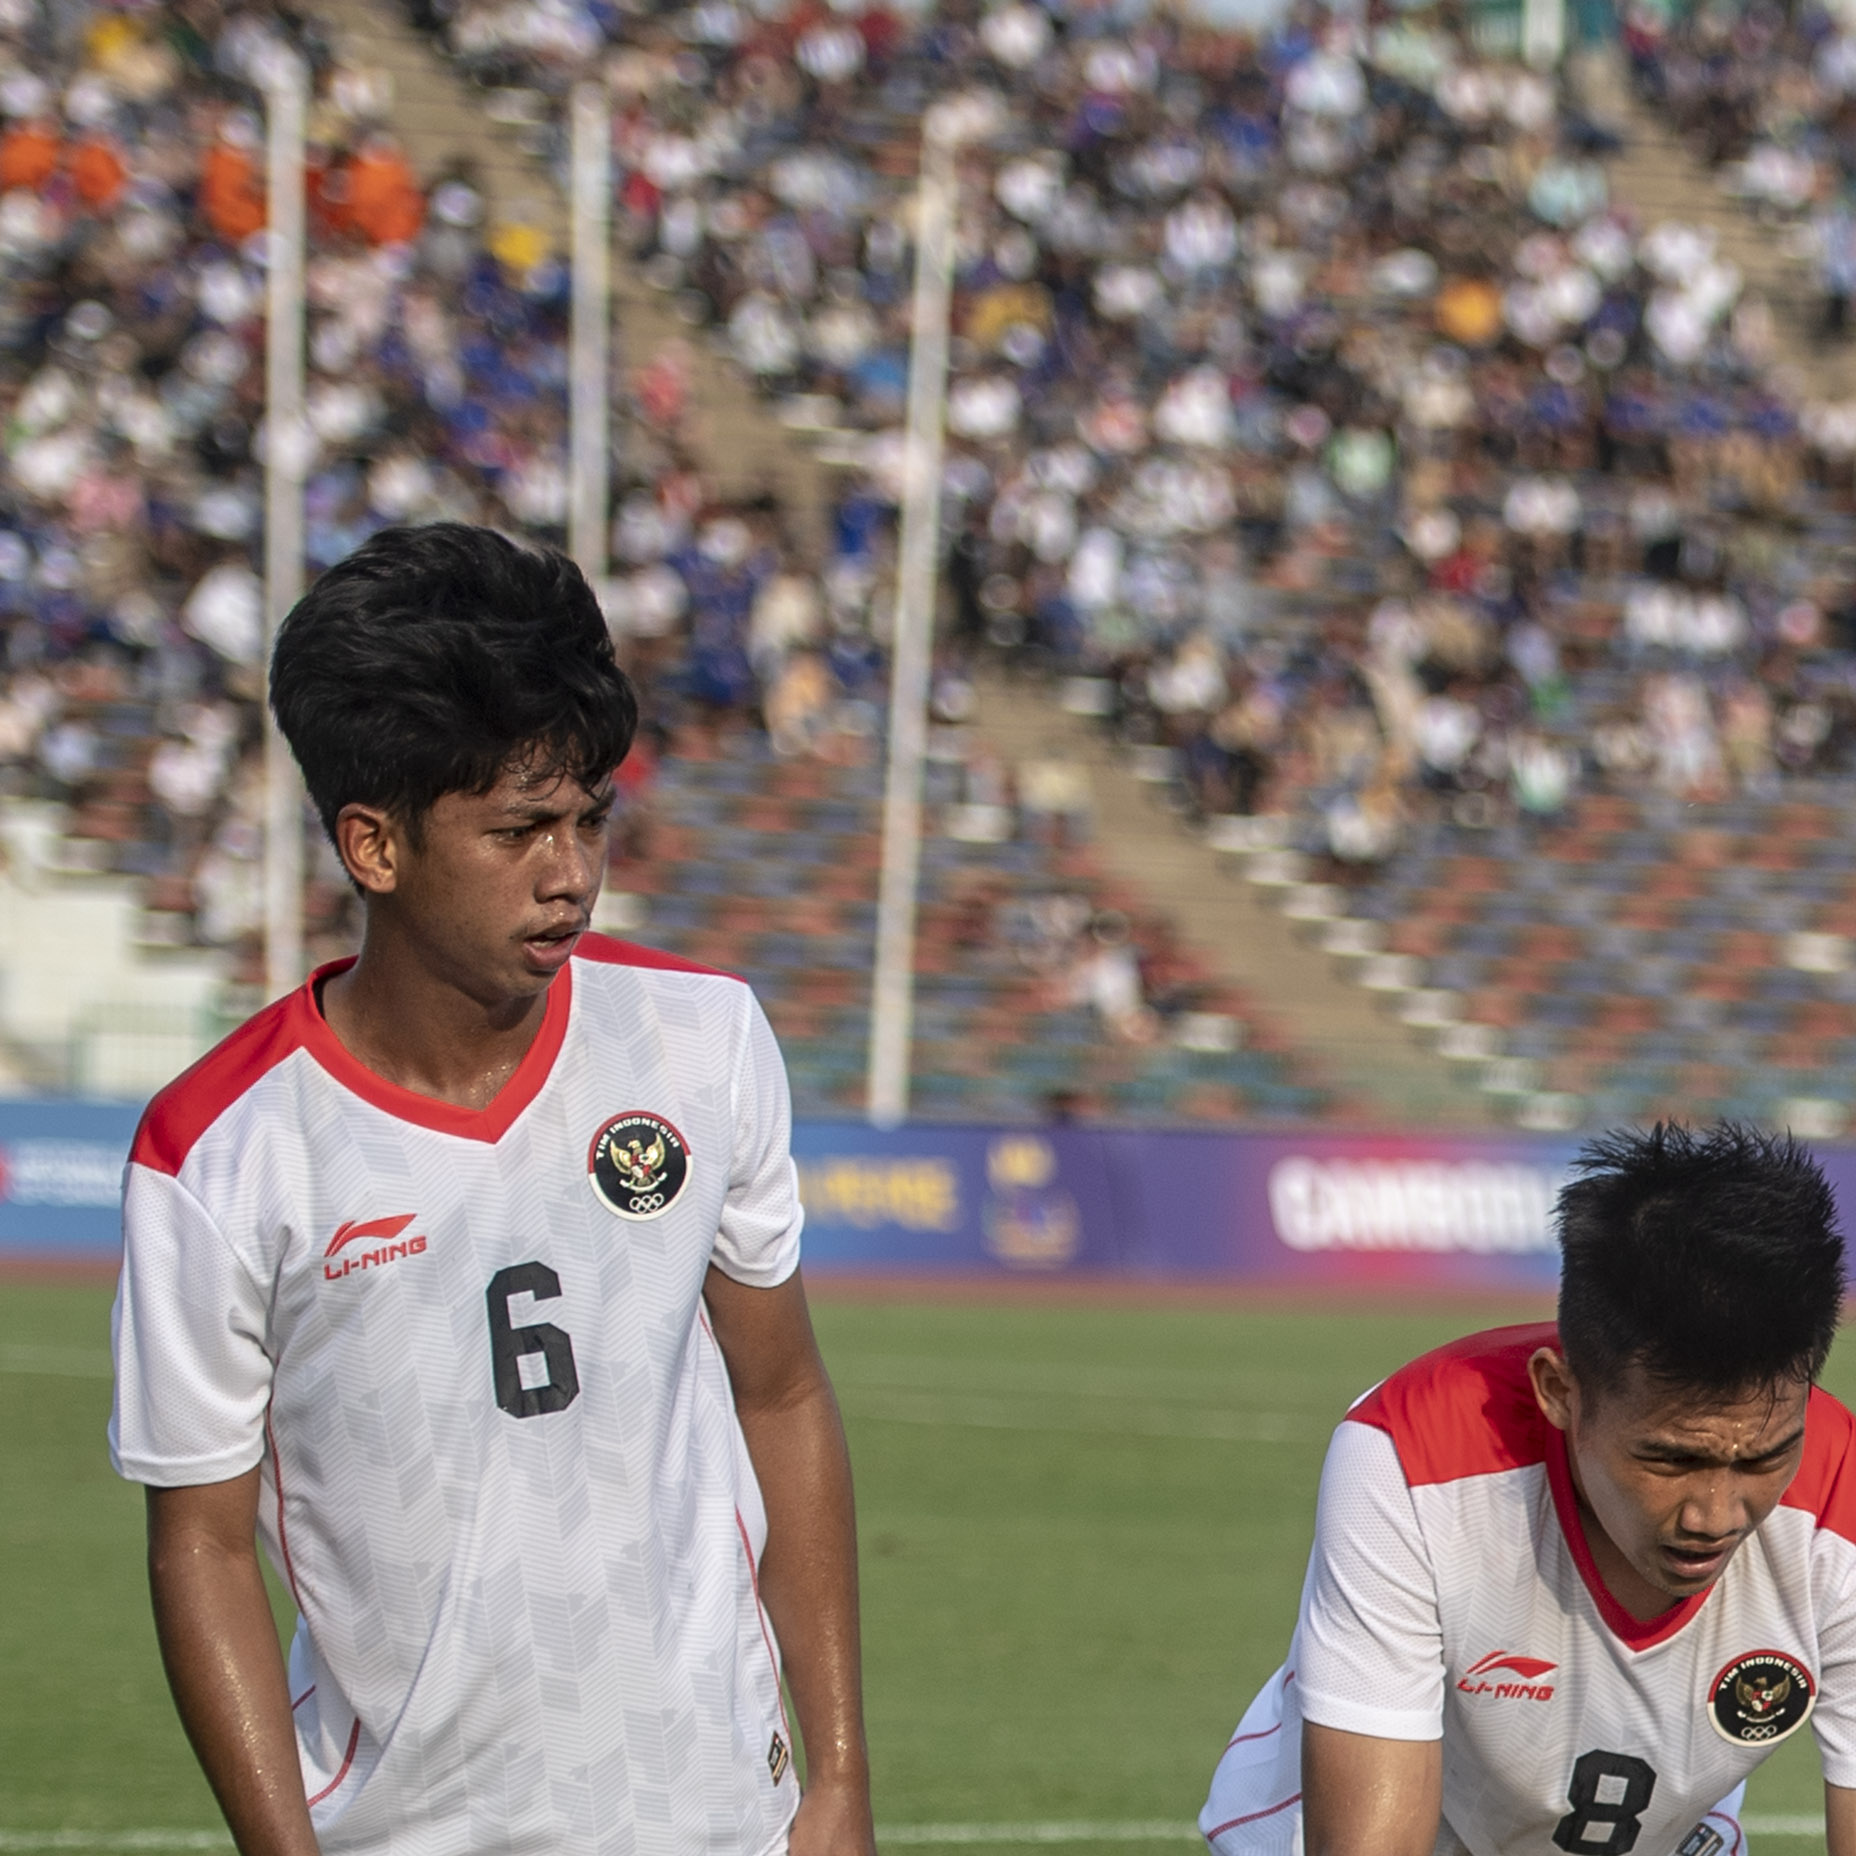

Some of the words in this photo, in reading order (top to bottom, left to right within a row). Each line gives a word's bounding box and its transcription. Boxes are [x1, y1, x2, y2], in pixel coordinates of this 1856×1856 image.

[596, 1134, 611, 1160] TIM
[609, 1117, 680, 1148] INDONESIA
[324, 1236, 427, 1280] LI-NING
[485, 1260, 580, 1419] 6
[1457, 1678, 1554, 1701] LI-NING
[1718, 1667, 1739, 1691] TIM
[1740, 1656, 1807, 1689] INDONESIA
